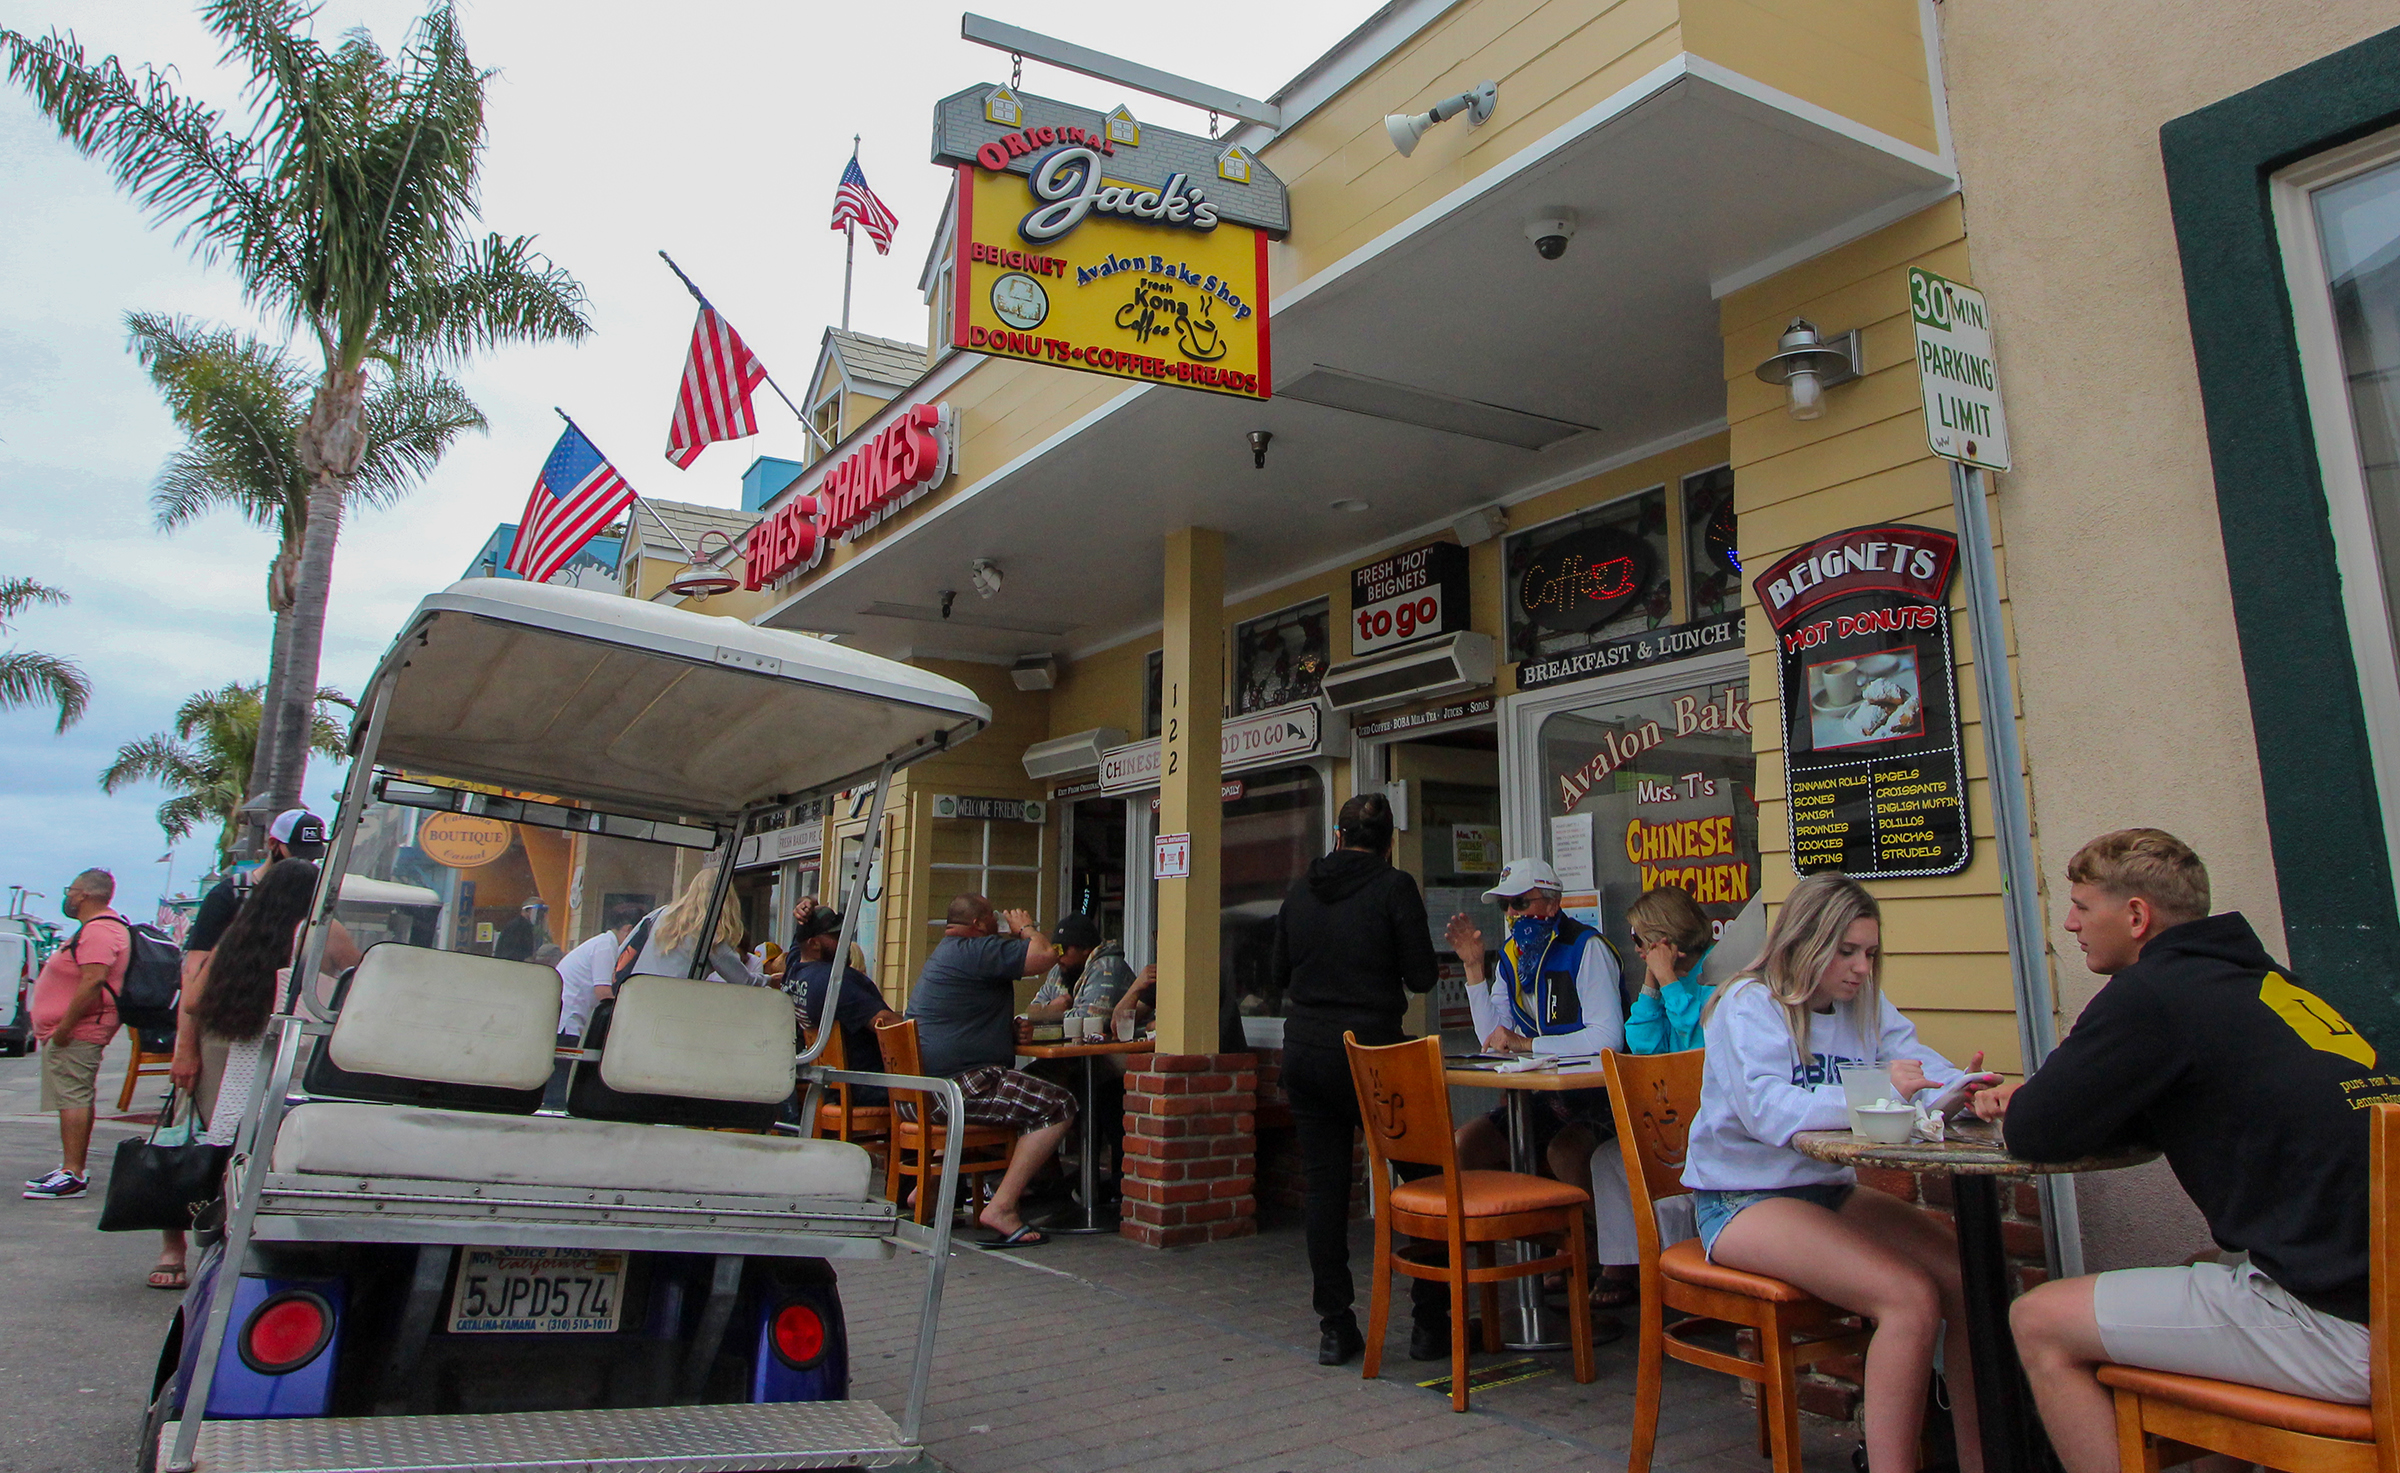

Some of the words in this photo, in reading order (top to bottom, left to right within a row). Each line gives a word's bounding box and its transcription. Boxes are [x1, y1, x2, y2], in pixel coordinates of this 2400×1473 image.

[976, 126, 1116, 171] ORIGINAL
[1018, 146, 1219, 245] Jack's
[971, 242, 1067, 278] BEIGNET
[1075, 253, 1146, 287] Avalon
[1148, 255, 1202, 287] Bake
[1203, 274, 1252, 321] Shop
[1134, 287, 1189, 317] Kona
[1140, 278, 1173, 295] Fresh
[1911, 272, 1949, 326] 30
[1950, 297, 1988, 331] MIN.
[1115, 303, 1170, 344] Coffee
[970, 325, 1072, 360] DONUTS
[1084, 345, 1166, 379] COFFEE
[1176, 360, 1259, 393] BREADS
[1921, 339, 1994, 392] PARKING
[1937, 392, 1991, 438] LIMIT
[743, 494, 820, 592] FRIES
[815, 404, 940, 541] SHAKES
[1356, 560, 1395, 588] FRESH
[1397, 547, 1434, 573] "HOT"
[1767, 541, 1937, 610] BEIGNETS
[1366, 568, 1427, 603] BEIGNETS
[1525, 555, 1608, 612] Coffee
[1357, 605, 1391, 641] to
[1395, 595, 1438, 638] go
[1783, 620, 1832, 654] HOT
[1836, 605, 1939, 641] DONUTS
[1524, 644, 1631, 685] BREAKFAST
[1636, 641, 1652, 660] &
[1658, 621, 1731, 656] LUNCH
[1393, 716, 1410, 730] BOBA
[1105, 750, 1161, 780] CHINESE
[1242, 728, 1260, 750] TO
[1264, 723, 1283, 746] GO
[1559, 720, 1664, 813] Avalon
[1221, 782, 1241, 798] DAILY
[1638, 779, 1677, 804] Mrs.
[1681, 771, 1715, 799] T's
[1792, 777, 1838, 793] CINNAMON
[1838, 775, 1867, 788] ROLLS
[1874, 769, 1920, 784] BAGELS
[1875, 782, 1947, 798] CROISSANTS
[957, 800, 991, 817] WELCOME
[993, 801, 1025, 819] FRIENDS
[1794, 794, 1835, 807] SCONES
[1795, 808, 1835, 822] DANISH
[1876, 800, 1921, 814] ENGLISH
[430, 830, 503, 846] BOUTIQUE
[1796, 823, 1849, 836] BROWNIES
[1878, 816, 1925, 830] BOLILLOS
[1880, 831, 1934, 845] CONCHAS
[1625, 815, 1733, 864] CHINESE
[1797, 838, 1843, 851] COOKIES
[1881, 845, 1942, 860] STRUDELS
[1798, 852, 1843, 866] MUFFINS
[1640, 860, 1749, 904] KITCHEN
[2339, 1078, 2368, 1093] pure.
[471, 1252, 492, 1264] NOV
[498, 1257, 597, 1275] California
[503, 1247, 547, 1258] Since
[466, 1275, 608, 1317] 5JPD574
[456, 1319, 500, 1331] CATALINA
[500, 1319, 536, 1330] YAMAHA
[547, 1319, 571, 1331] (310)
[572, 1319, 613, 1331] 510-1011
